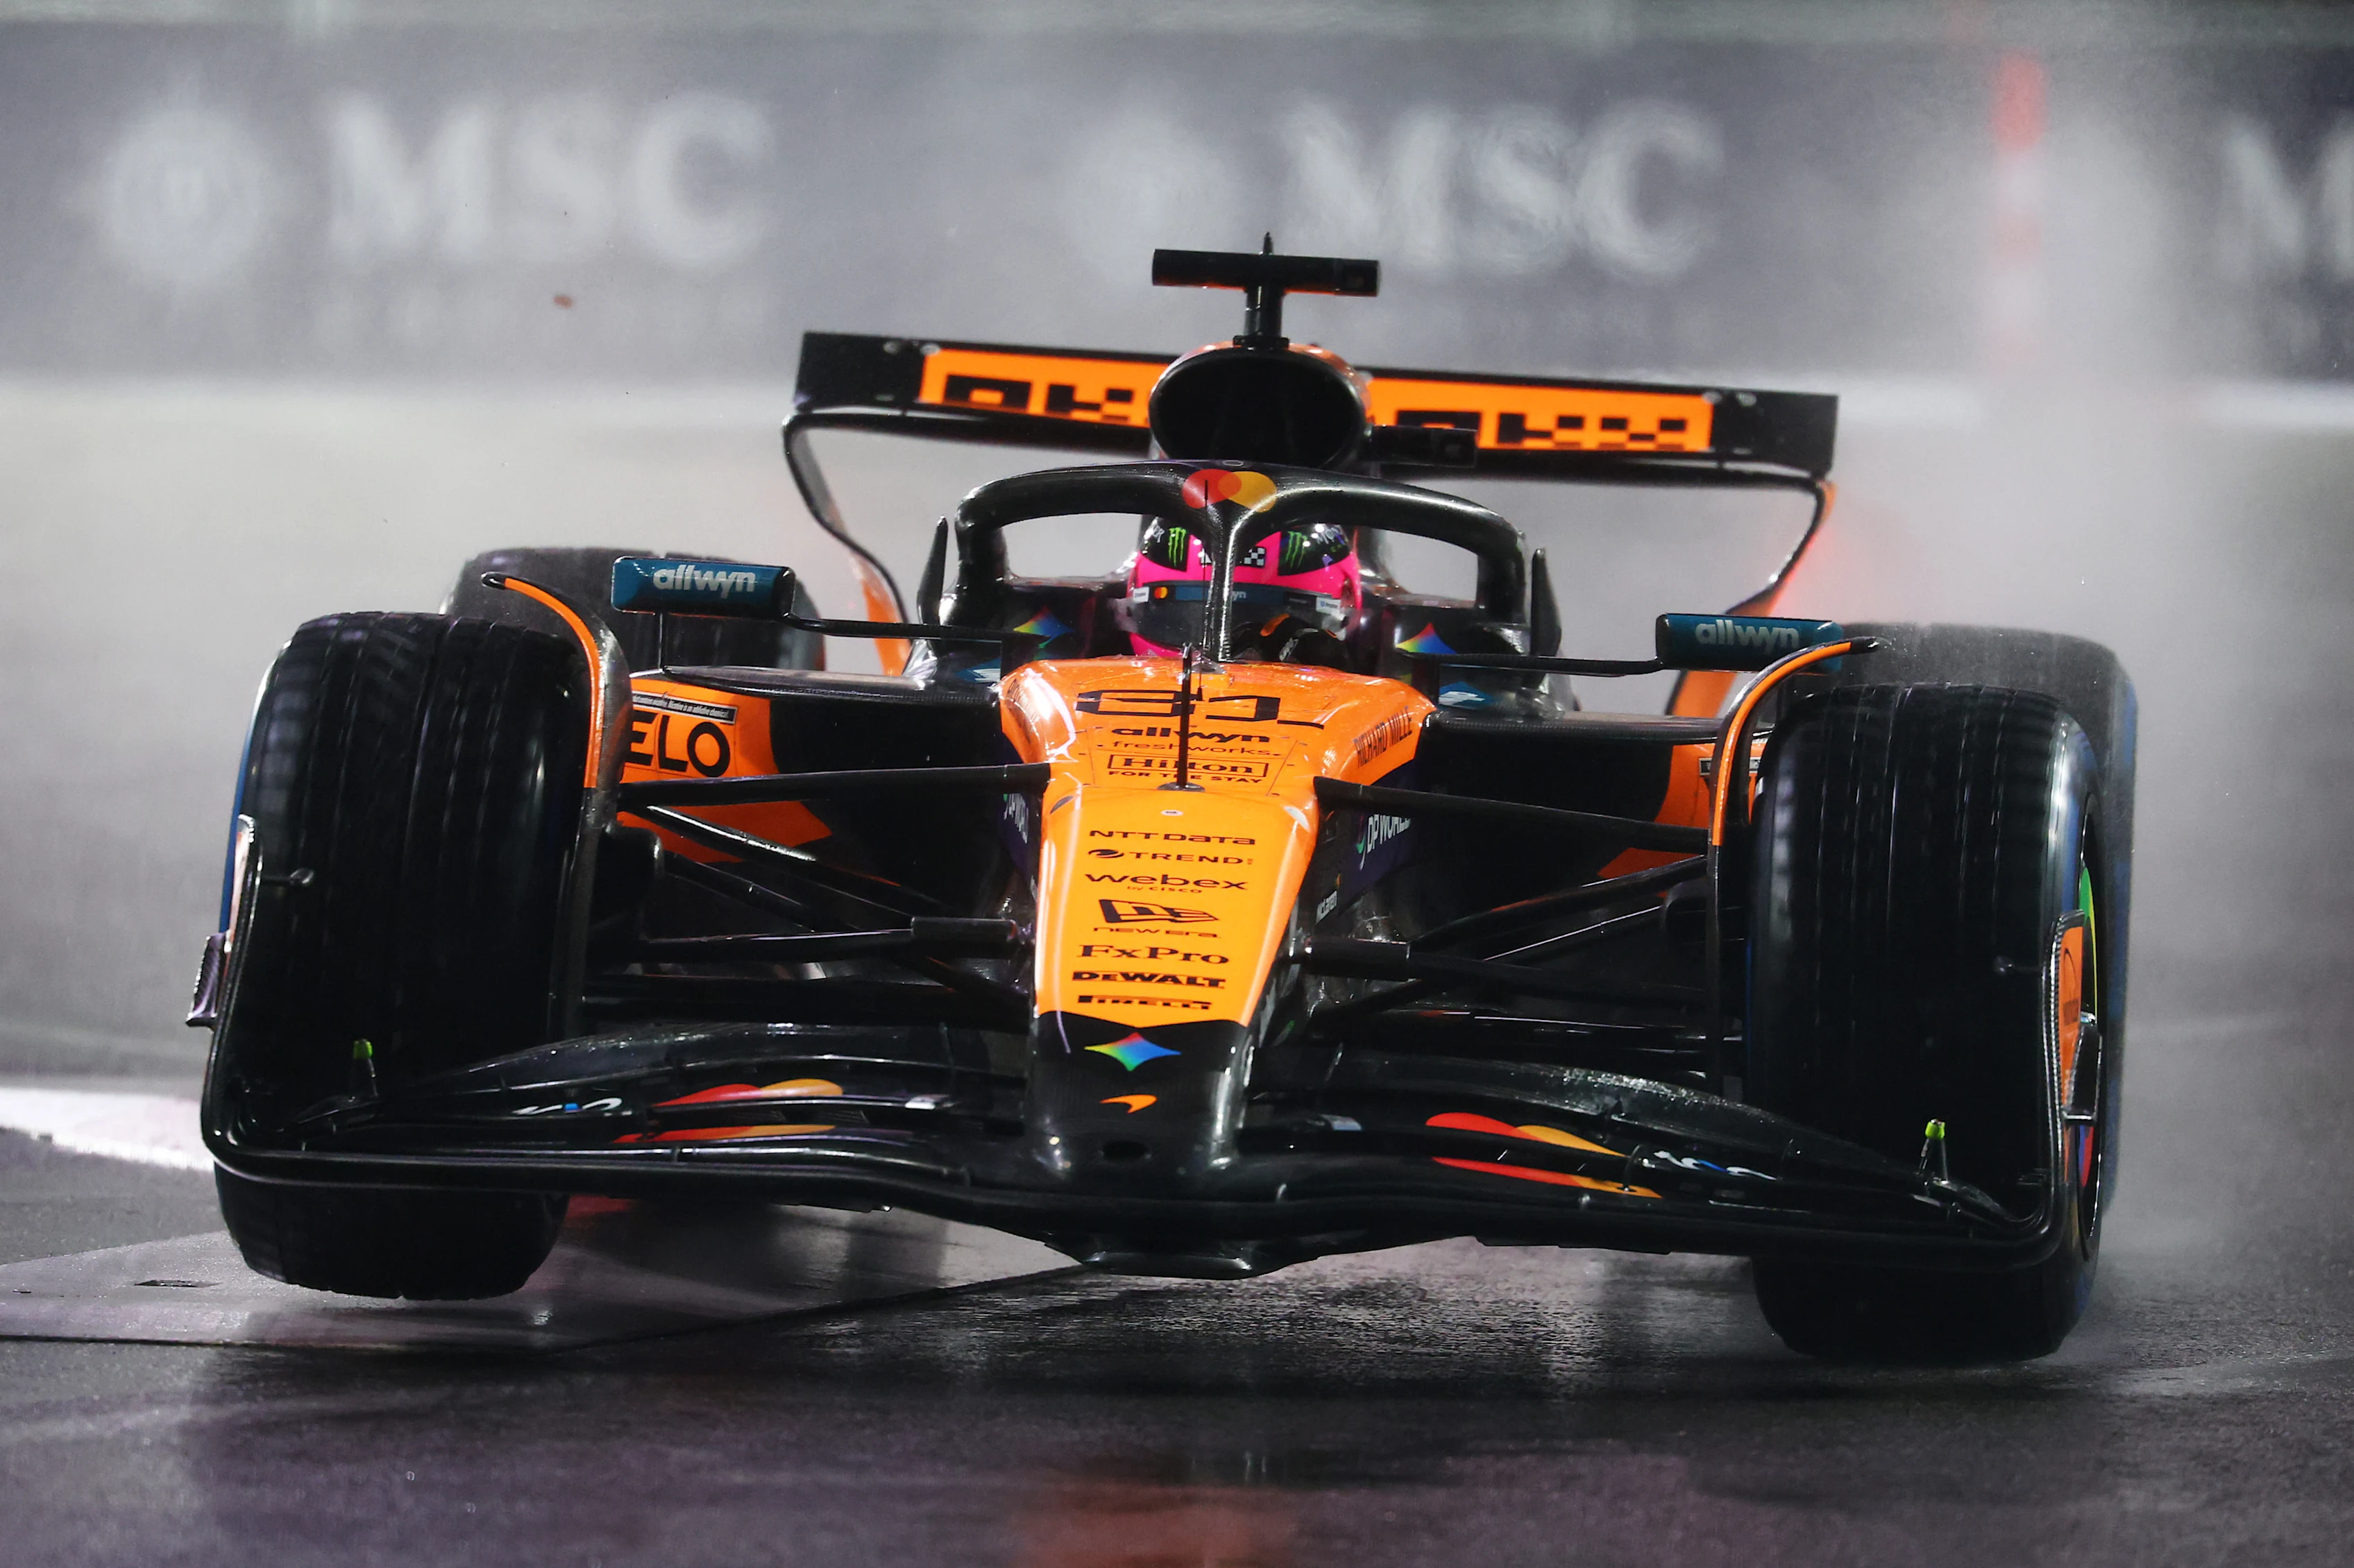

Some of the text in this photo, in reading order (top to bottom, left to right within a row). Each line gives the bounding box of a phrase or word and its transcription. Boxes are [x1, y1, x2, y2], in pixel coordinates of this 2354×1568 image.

[328, 91, 776, 270] MSC
[1277, 99, 1725, 280] MSC
[943, 373, 1149, 421] OK
[653, 565, 756, 599] allwyn
[1695, 620, 1799, 654] allwyn
[1076, 690, 1324, 730] 81
[1112, 727, 1270, 743] allwyn
[1112, 741, 1271, 756] freshworks
[1089, 830, 1158, 840] NTT
[1129, 851, 1243, 864] TREND
[1084, 874, 1248, 891] webex
[1076, 944, 1230, 964] FxPro
[1078, 995, 1212, 1009] PIRELLI
